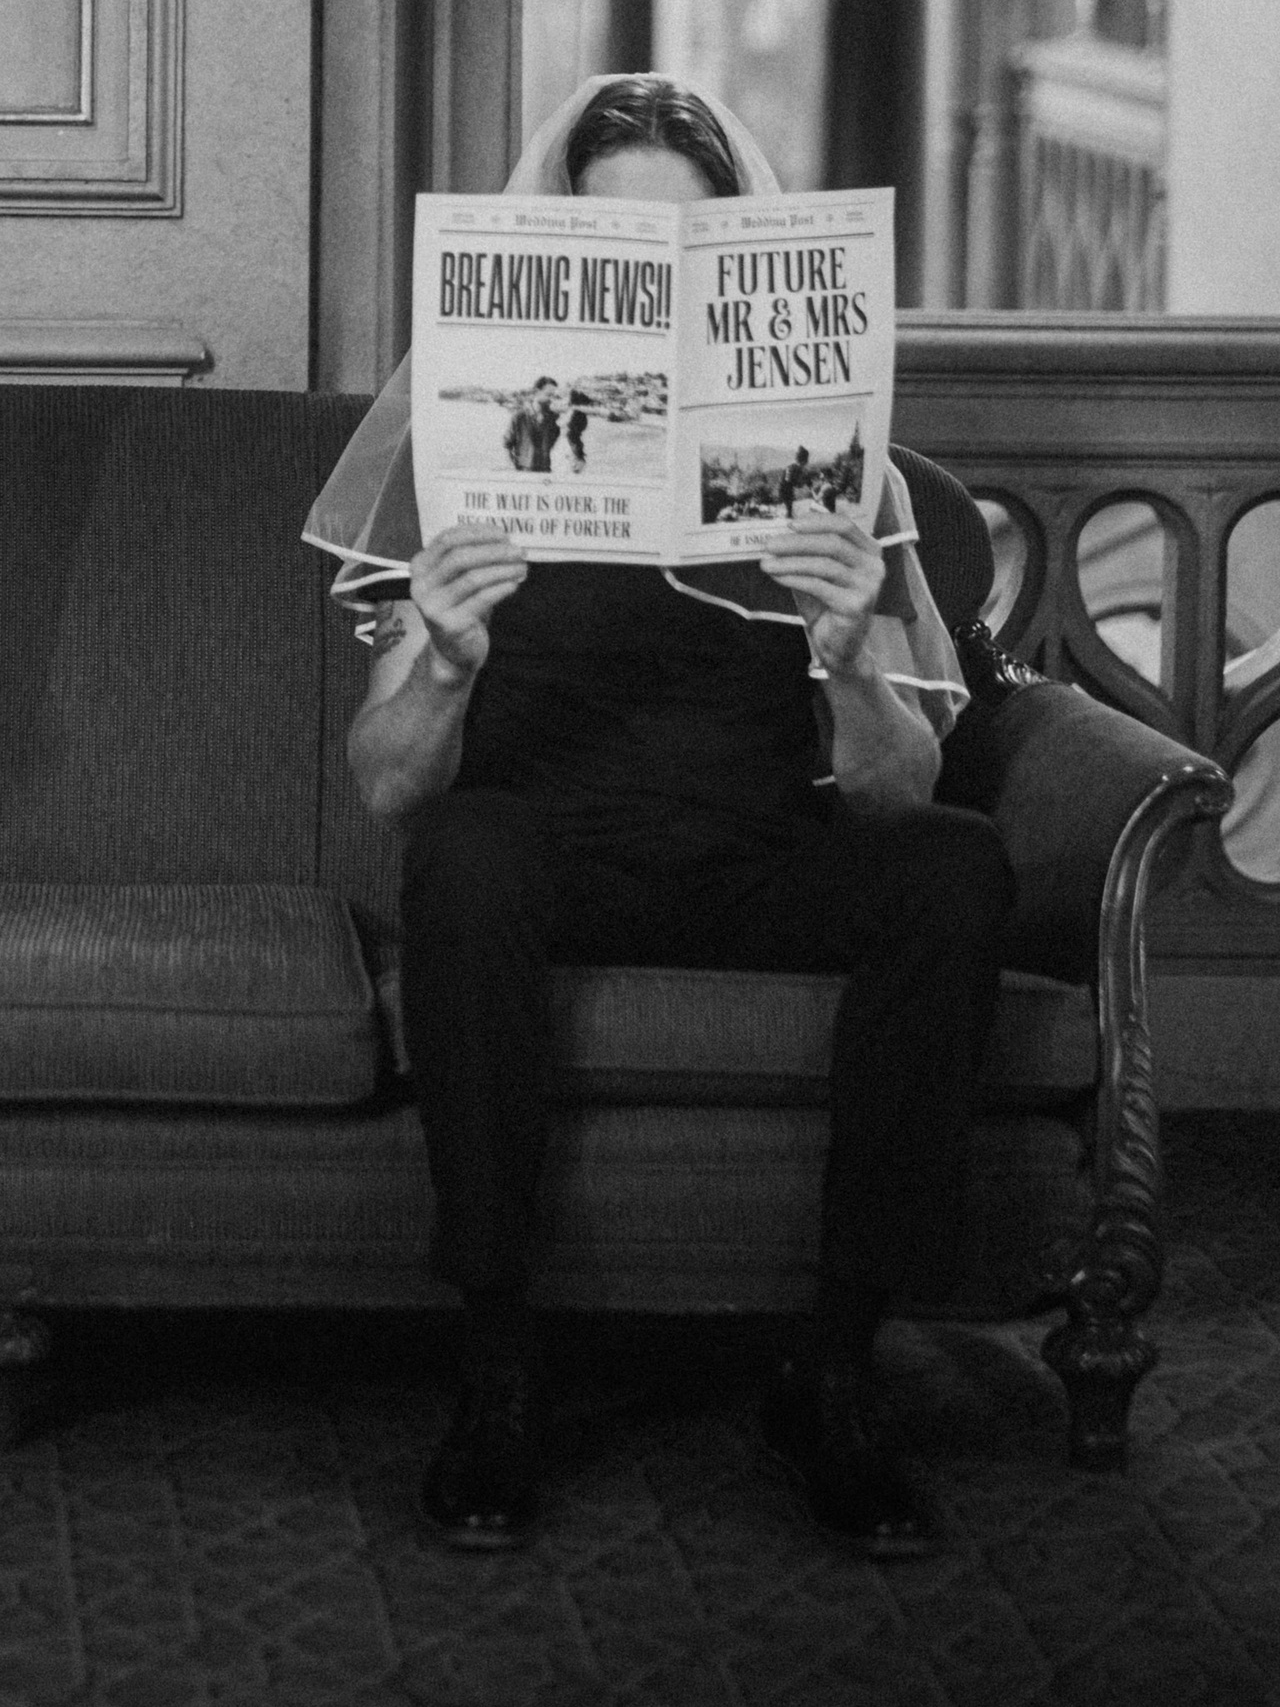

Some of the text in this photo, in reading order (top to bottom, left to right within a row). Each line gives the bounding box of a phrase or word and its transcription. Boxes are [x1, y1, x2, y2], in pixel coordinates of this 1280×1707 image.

[439, 251, 672, 330] BREAKING NEWS!!
[717, 246, 847, 298] FUTURE
[706, 292, 868, 345] MR & MRS
[726, 341, 850, 391] JENSEN
[464, 491, 489, 510] THE
[496, 493, 531, 511] WAIT
[537, 495, 550, 512] IS
[602, 497, 631, 515] THE
[540, 517, 559, 536] OF
[564, 519, 631, 539] FOREVER
